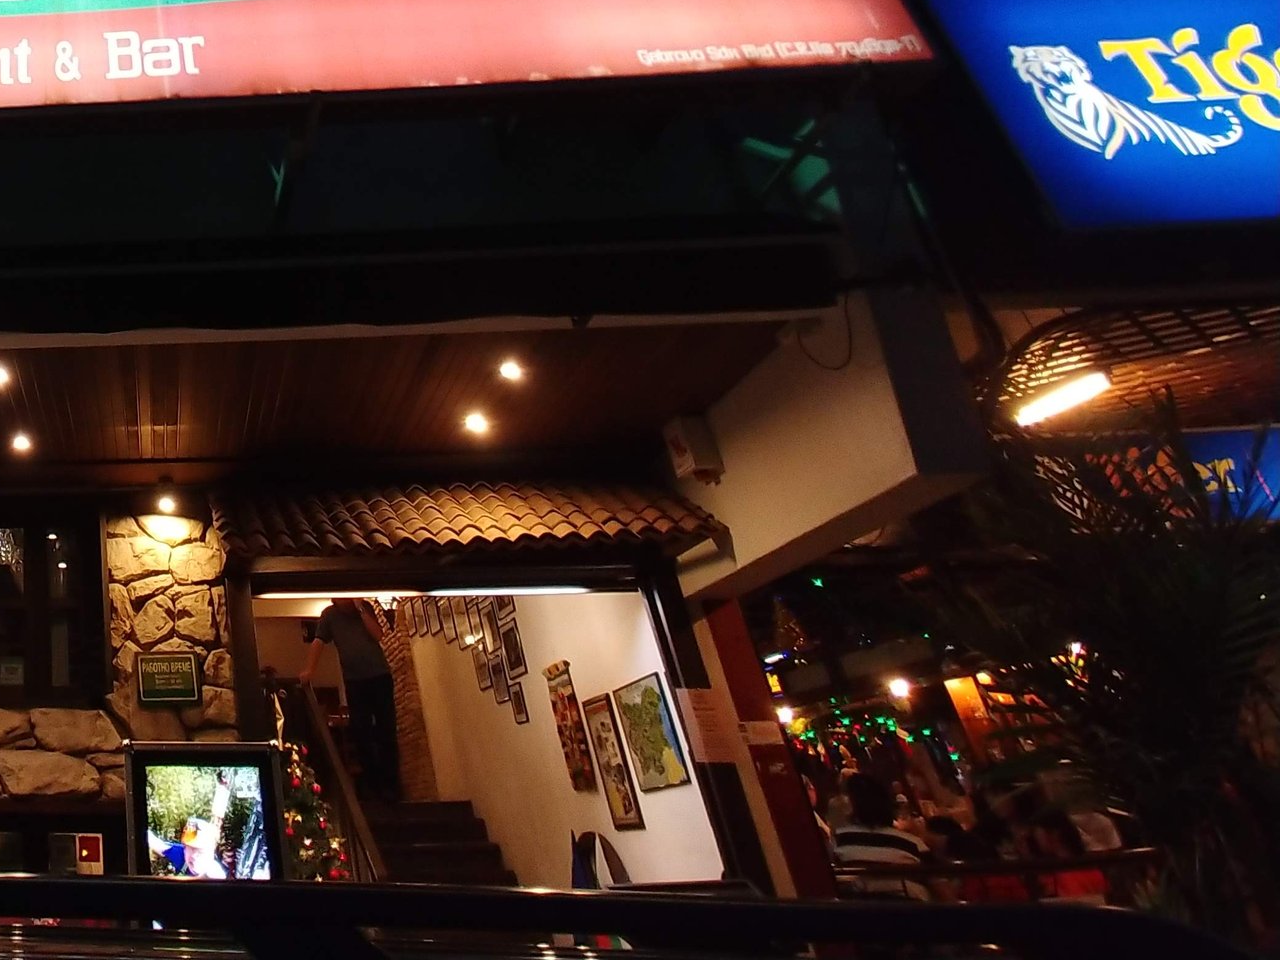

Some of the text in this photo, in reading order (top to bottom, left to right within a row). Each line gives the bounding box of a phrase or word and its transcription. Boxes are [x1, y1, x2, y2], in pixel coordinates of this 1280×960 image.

[54, 40, 82, 82] &
[104, 32, 205, 80] Bar
[1098, 23, 1280, 132] Tig
